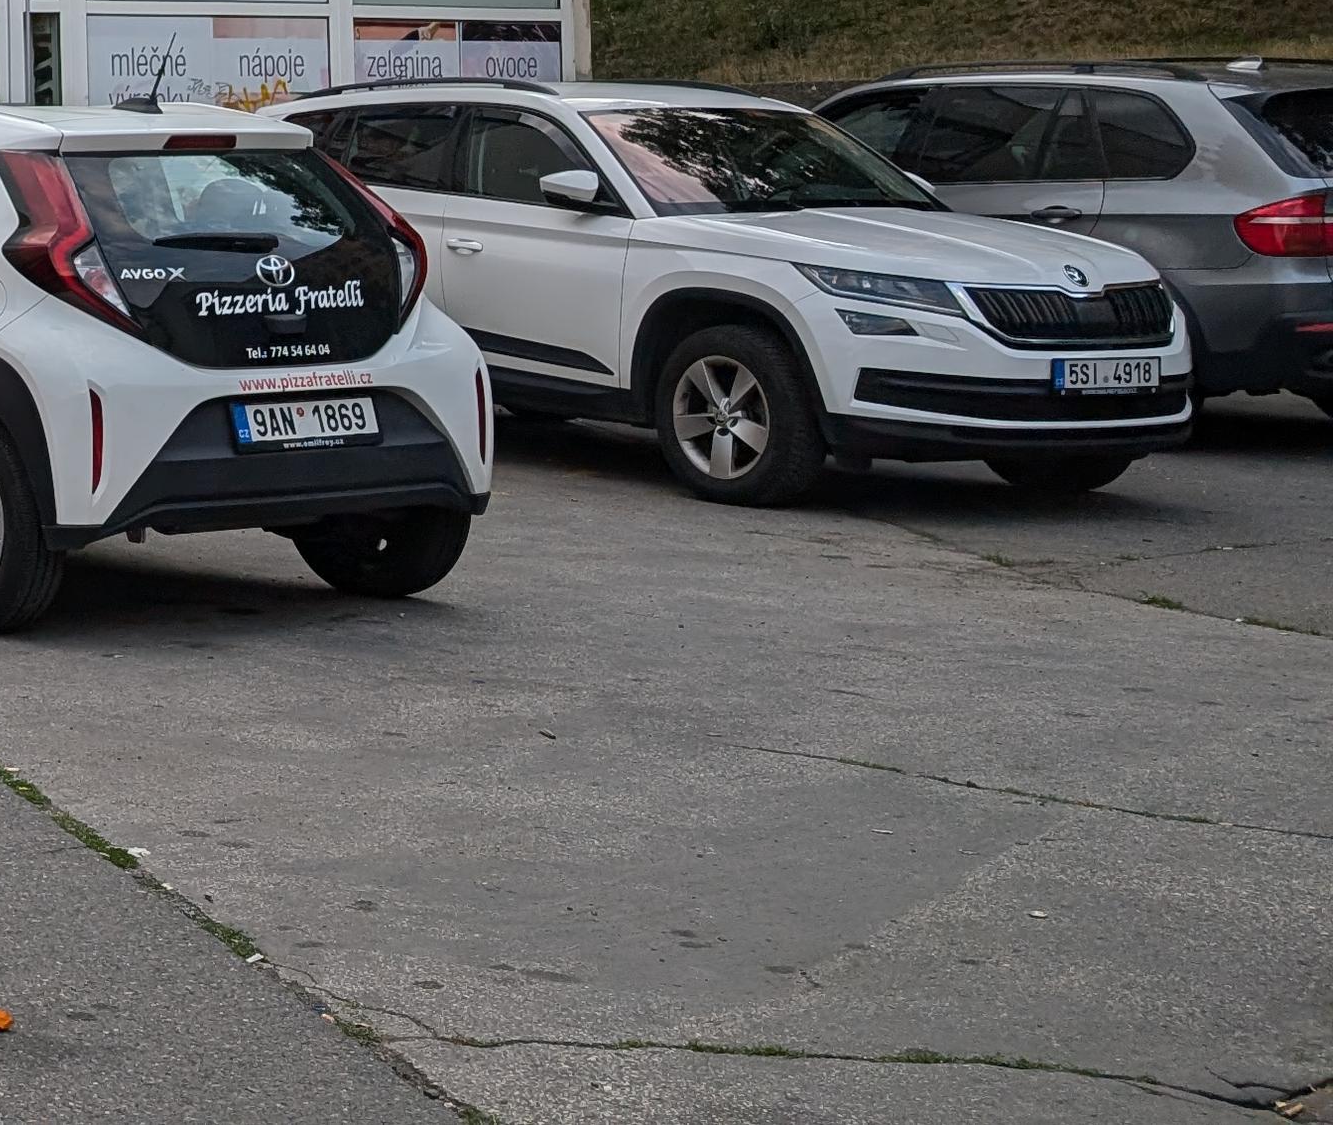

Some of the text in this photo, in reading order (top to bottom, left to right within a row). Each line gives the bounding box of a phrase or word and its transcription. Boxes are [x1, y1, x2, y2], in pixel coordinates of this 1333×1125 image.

[111, 46, 187, 77] mléčné
[239, 47, 305, 83] nápoje
[367, 50, 443, 78] zelenina
[486, 57, 538, 78] ovoce
[196, 279, 364, 317] Pizzeria Fratelli
[246, 343, 331, 359] Tel.: 774 54 64 04
[238, 370, 374, 392] www.pizzafratelli.cz
[1113, 362, 1152, 384] 4918
[253, 402, 367, 437] 9AN 1869
[238, 429, 250, 438] CZ
